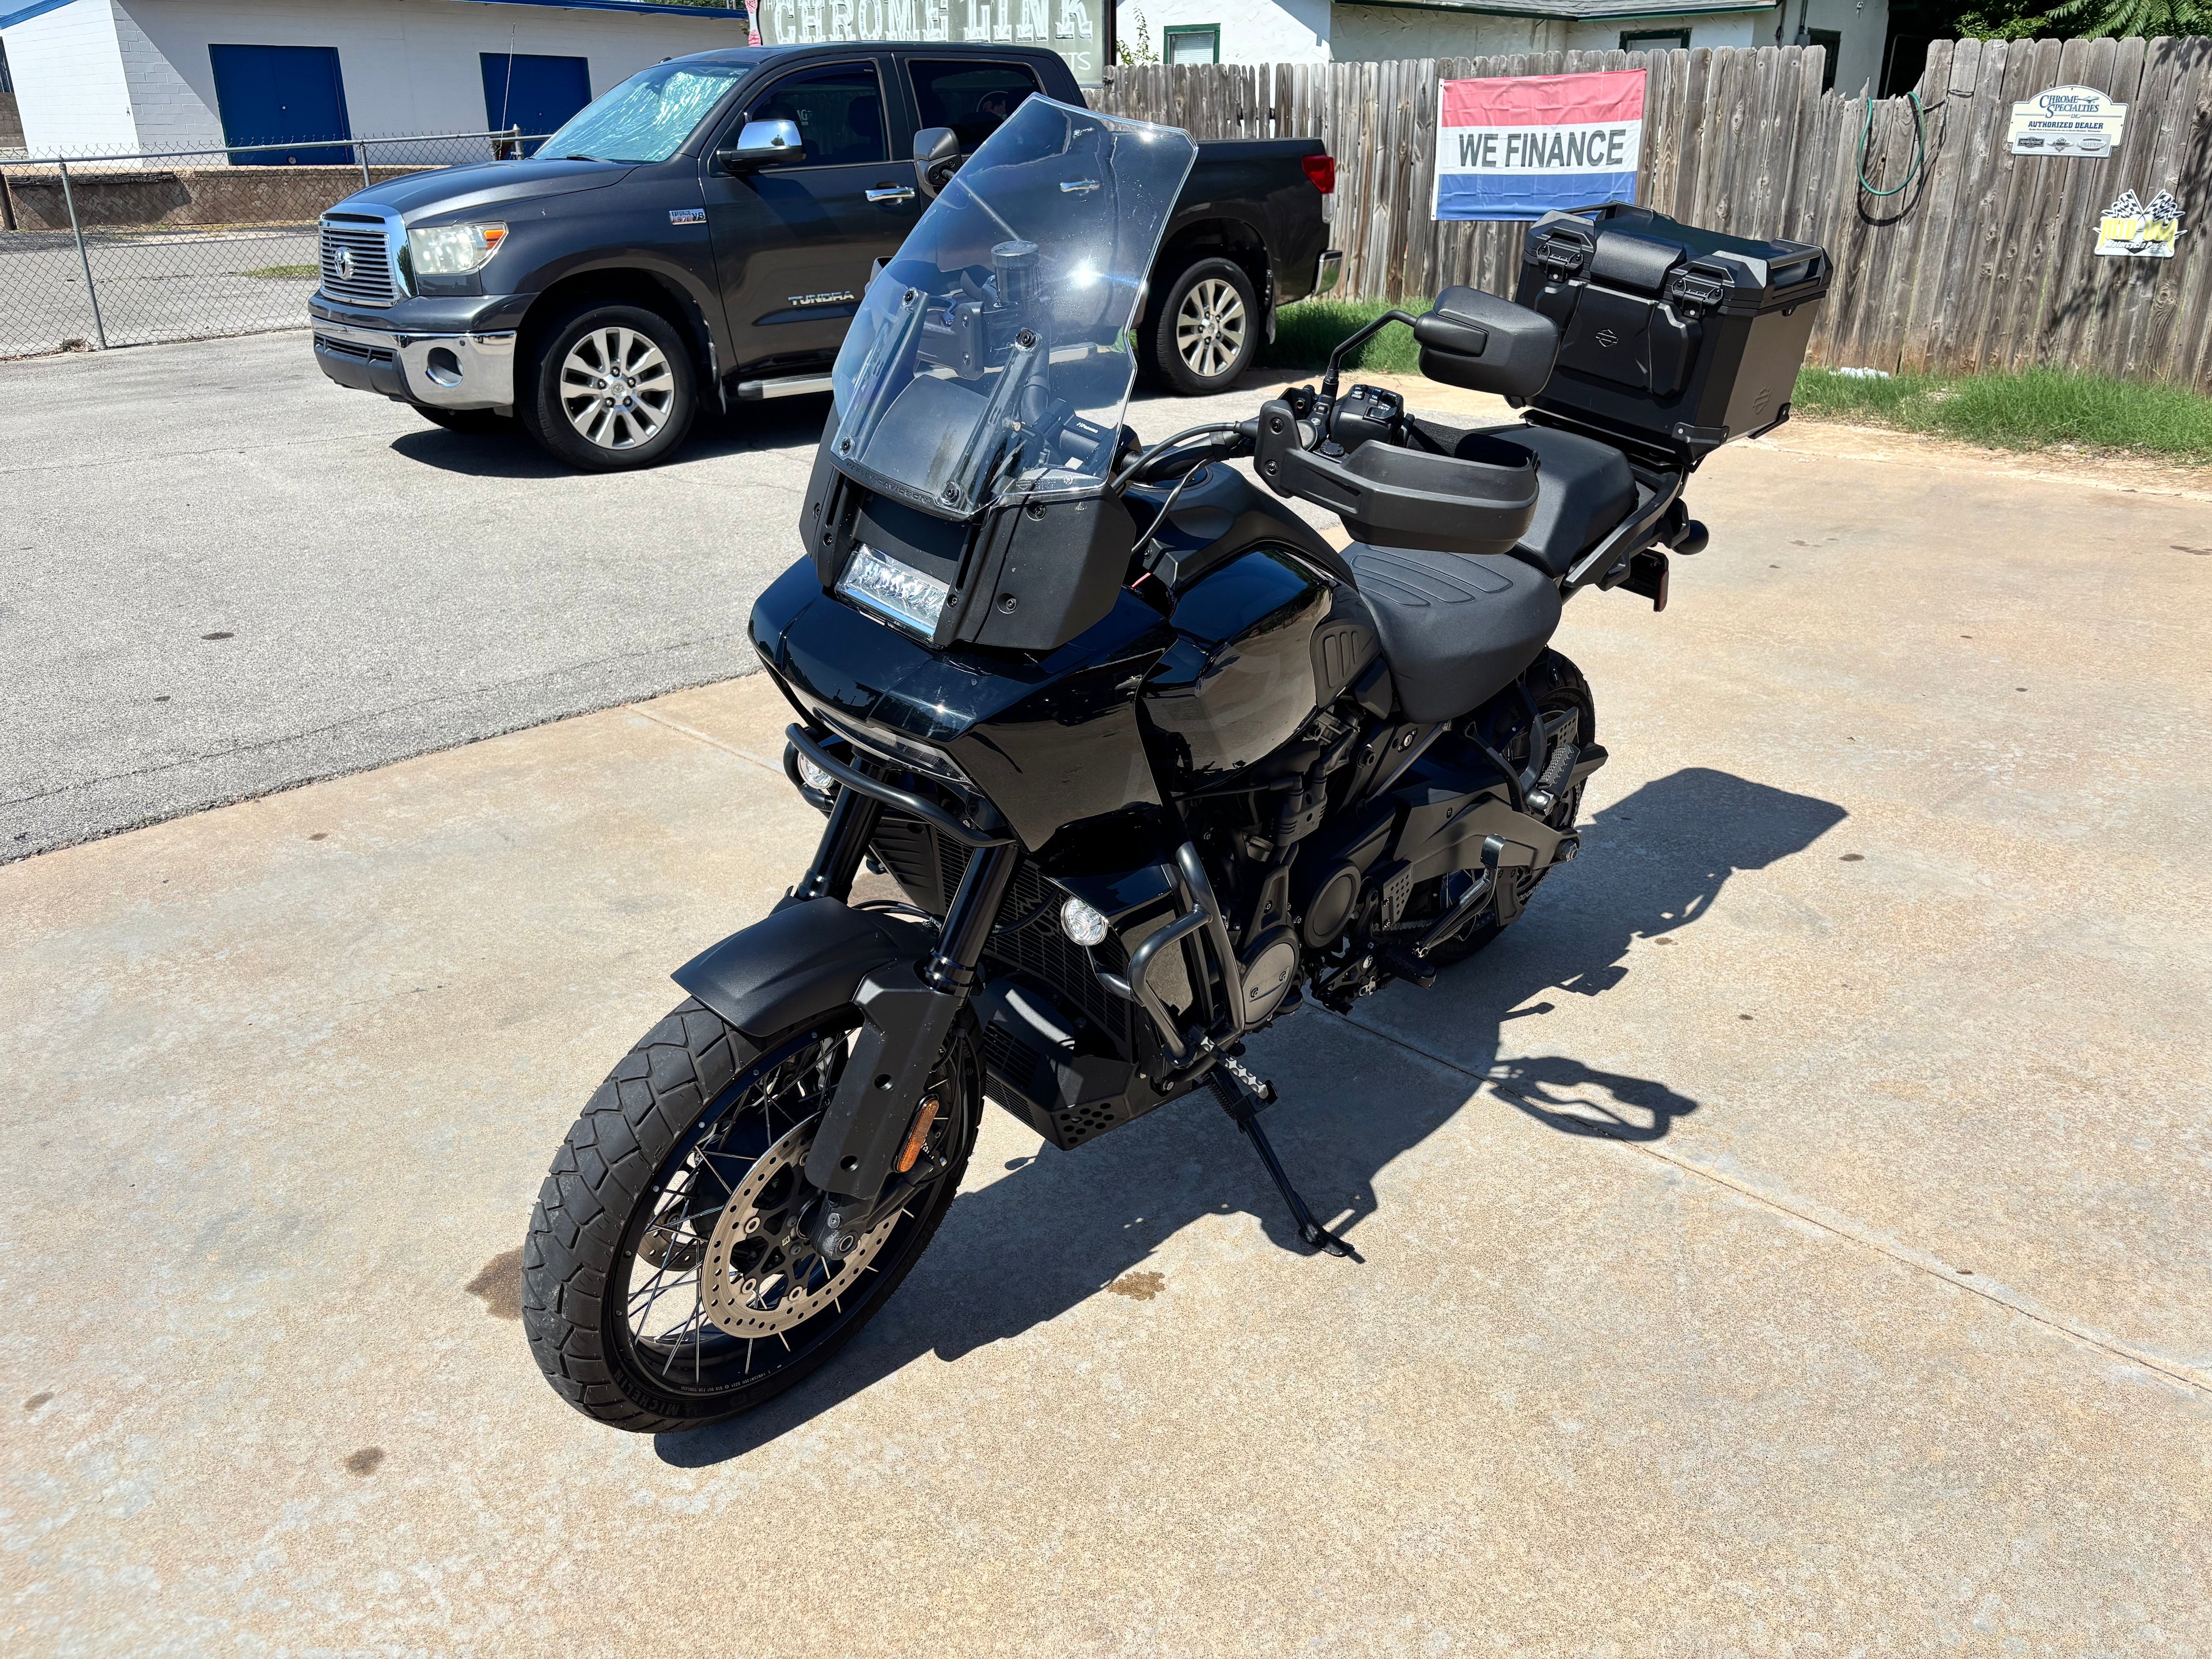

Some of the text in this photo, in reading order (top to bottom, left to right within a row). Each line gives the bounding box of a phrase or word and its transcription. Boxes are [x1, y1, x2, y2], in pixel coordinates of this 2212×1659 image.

[774, 0, 1093, 44] CHROME LINK
[2039, 94, 2078, 108] CHROME
[2045, 104, 2100, 119] SPECIALTIES
[1459, 128, 1627, 168] WE FINANCE
[788, 290, 855, 306] TUNDRA
[613, 1368, 680, 1416] MICHELIN
